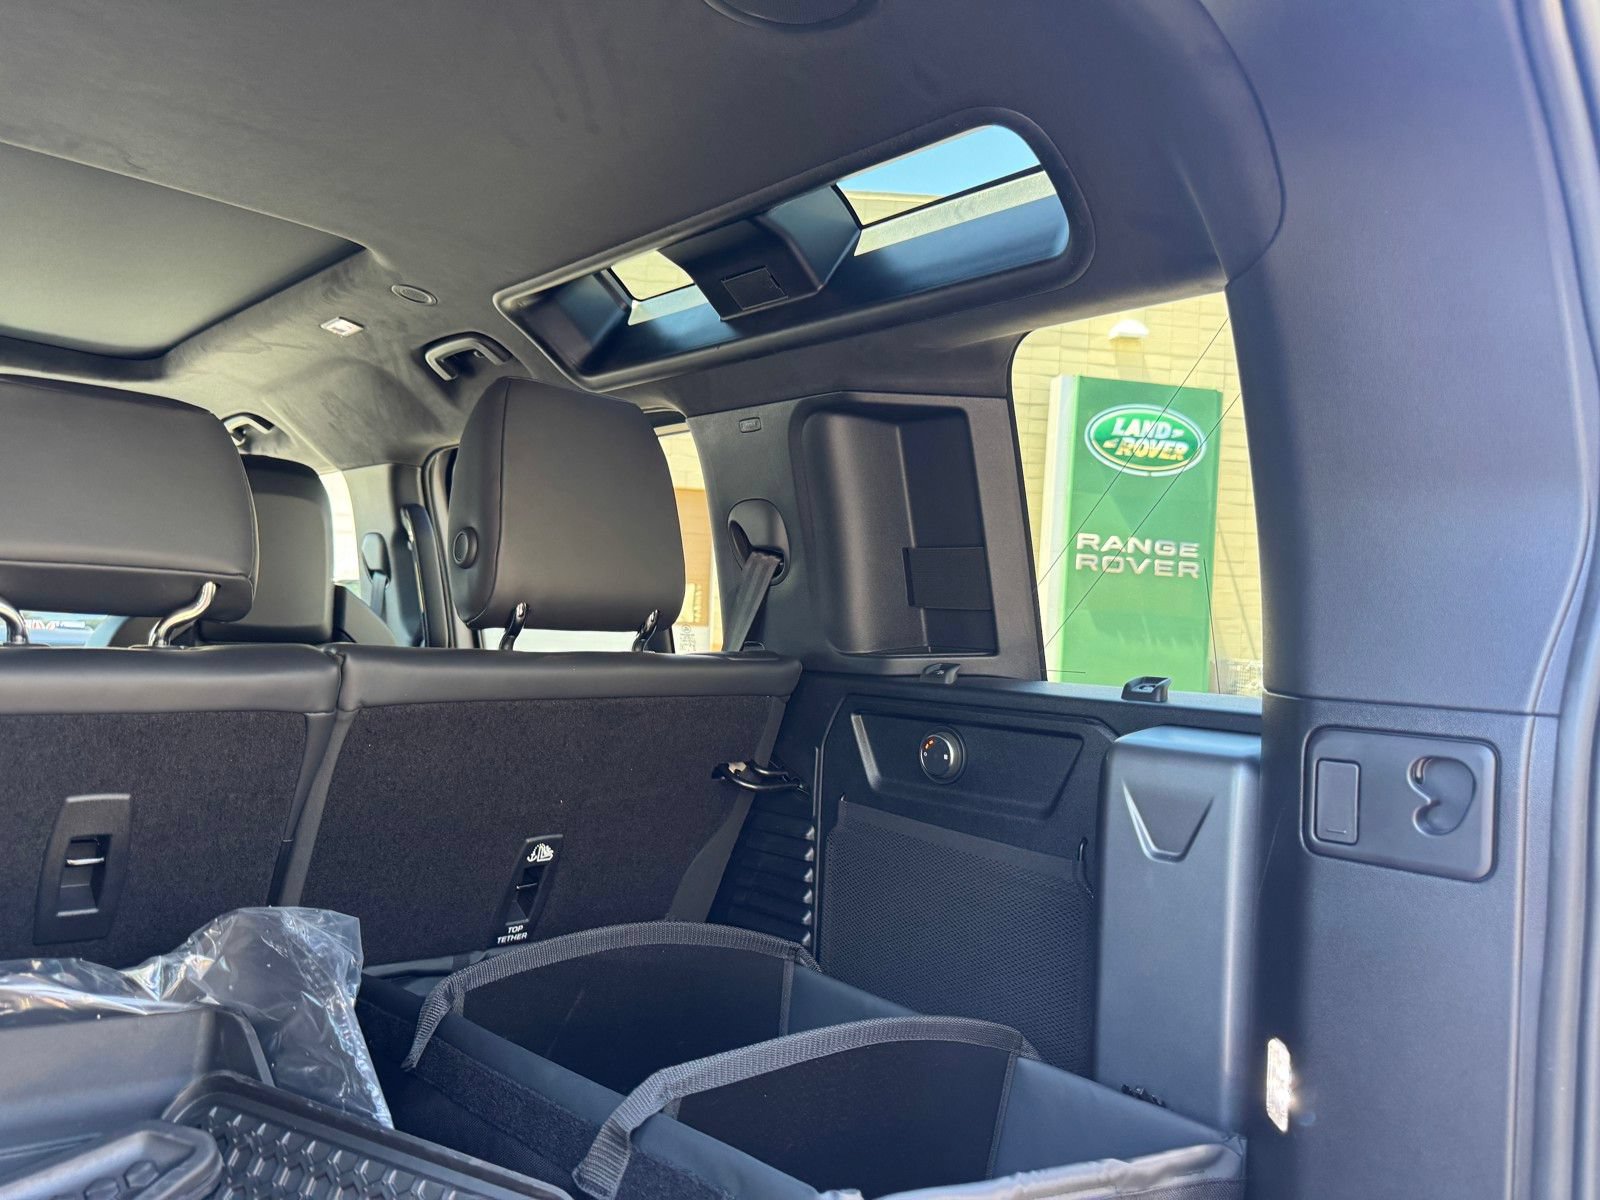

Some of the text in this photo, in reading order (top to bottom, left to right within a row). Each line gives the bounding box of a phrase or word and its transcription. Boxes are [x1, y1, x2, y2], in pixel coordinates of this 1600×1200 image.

[1111, 416, 1171, 440] LAND
[1115, 437, 1190, 461] ROVER
[1076, 532, 1200, 558] RANGE
[1074, 553, 1200, 579] ROVER
[497, 932, 528, 944] TETHER
[508, 924, 524, 934] TOP
